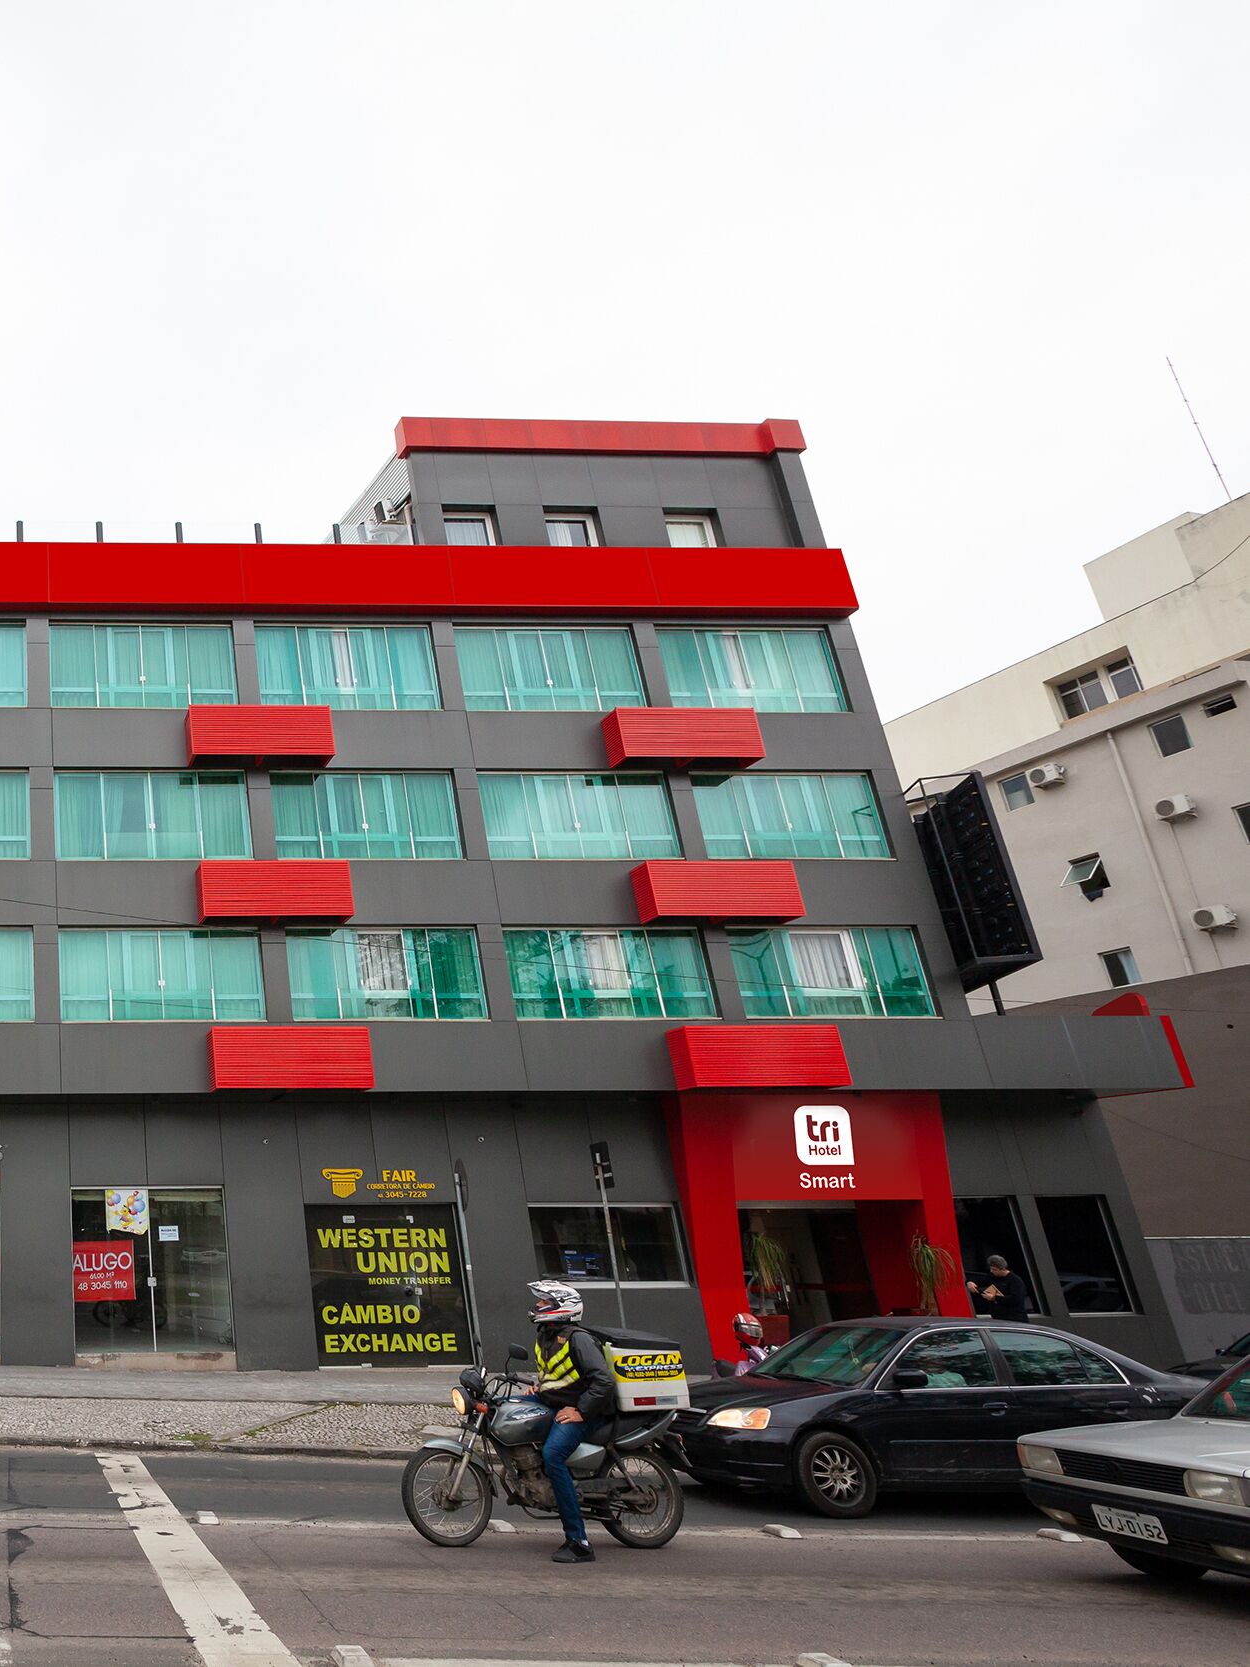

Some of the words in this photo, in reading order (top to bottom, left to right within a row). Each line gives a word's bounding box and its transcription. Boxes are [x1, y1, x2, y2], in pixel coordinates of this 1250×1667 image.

[806, 1115, 840, 1142] tri
[808, 1145, 842, 1156] Hotel
[382, 1169, 418, 1182] FAIR
[800, 1172, 856, 1189] Smart
[366, 1182, 401, 1190] CORRETORA
[403, 1182, 412, 1190] DE
[385, 1191, 427, 1199] 3045-7228
[317, 1228, 448, 1249] WESTERN
[73, 1251, 133, 1272] ALUGO
[356, 1251, 451, 1274] UNION
[77, 1281, 88, 1291] 48
[91, 1280, 112, 1290] 3045
[368, 1276, 401, 1285] MONEY
[403, 1276, 452, 1285] TRANSFER
[321, 1302, 421, 1324] CÂMBIO
[324, 1333, 458, 1353] EXCHANGE
[616, 1354, 680, 1366] LOGAN
